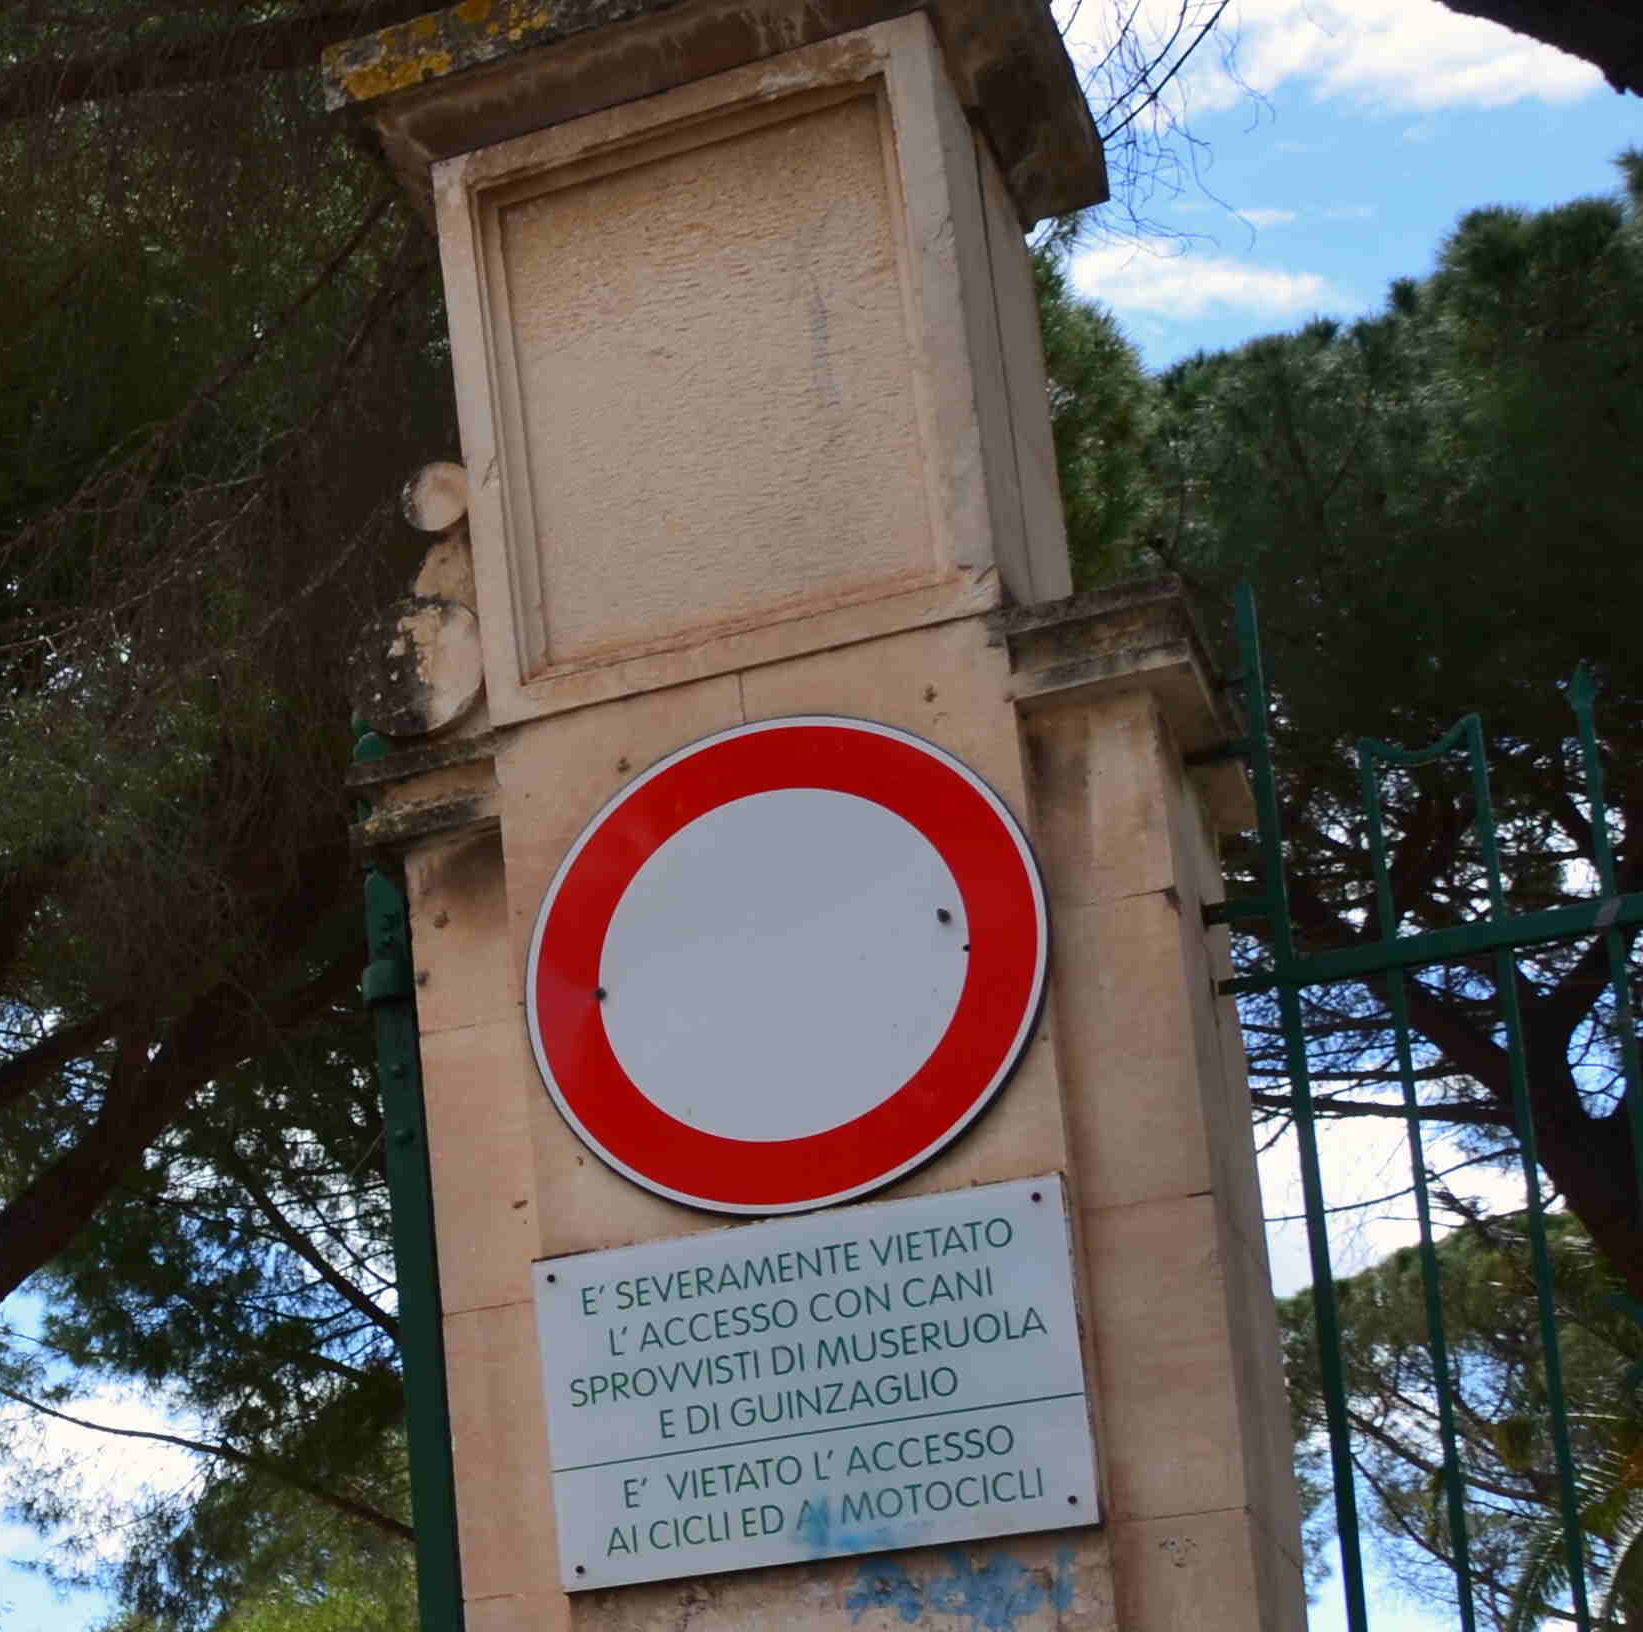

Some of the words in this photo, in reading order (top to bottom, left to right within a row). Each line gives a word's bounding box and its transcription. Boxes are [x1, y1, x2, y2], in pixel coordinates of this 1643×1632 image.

[614, 1241, 861, 1311] SEVERAMENTE
[869, 1217, 1014, 1267] VIETATO
[639, 1298, 799, 1353] ACCESSO
[809, 1288, 892, 1323] CON
[902, 1265, 995, 1308] CANI
[568, 1342, 761, 1408] SPROVVISTI
[770, 1342, 806, 1377] DI
[816, 1306, 1048, 1371] MUSERUOLA
[658, 1408, 676, 1440] E
[685, 1401, 721, 1436] DI
[730, 1366, 959, 1428] GUINZAGLIO
[666, 1455, 803, 1501] VIETATO
[846, 1424, 1015, 1477] ACCESSO
[606, 1523, 639, 1558] AI
[648, 1511, 732, 1550] CICLI
[740, 1504, 786, 1538] ED
[841, 1466, 1044, 1524] MOTOCICLI
